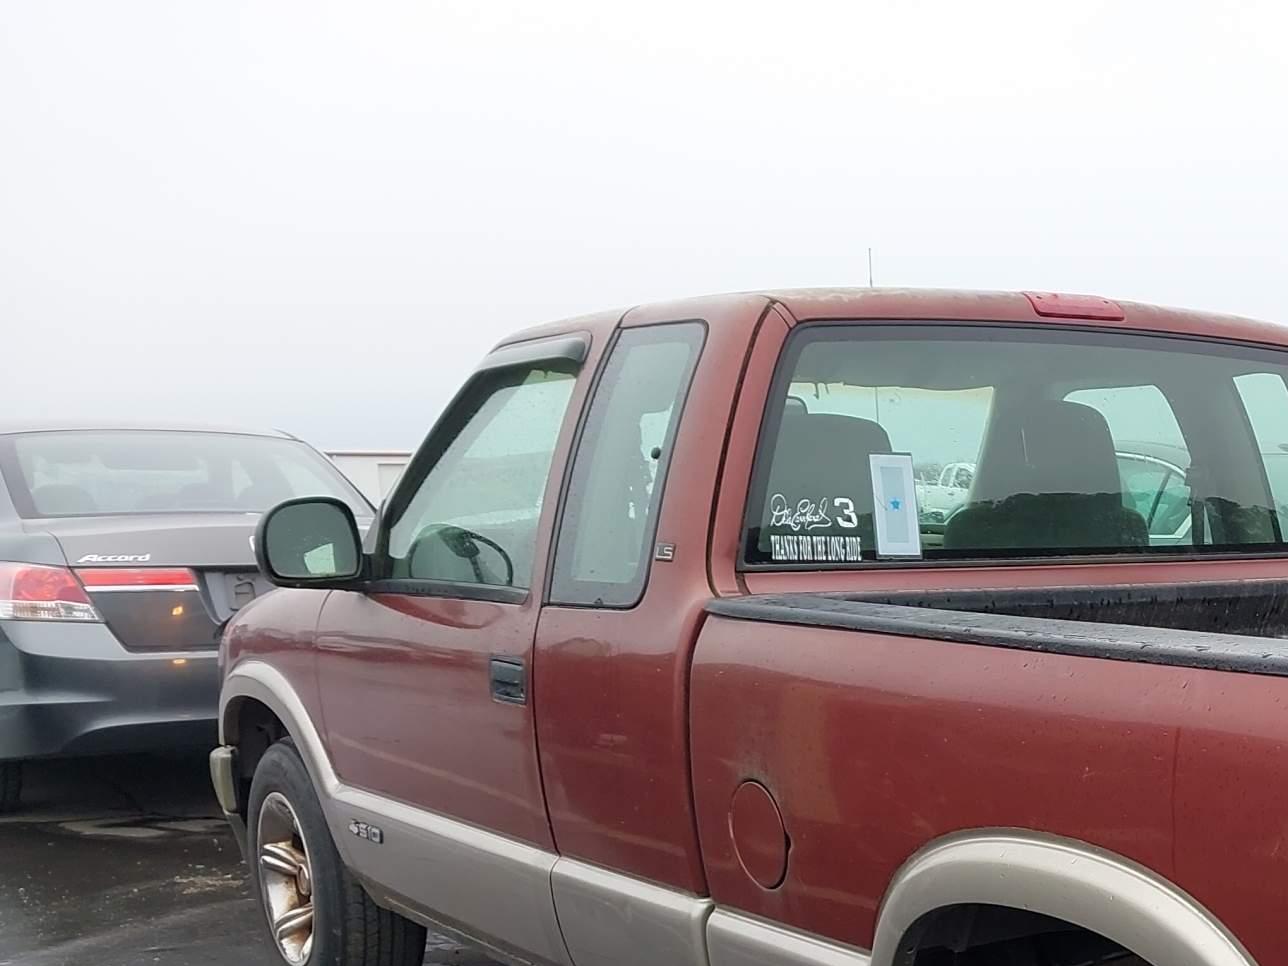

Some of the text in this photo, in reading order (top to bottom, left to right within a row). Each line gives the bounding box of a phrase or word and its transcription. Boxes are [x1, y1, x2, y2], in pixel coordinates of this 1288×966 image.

[834, 497, 858, 528] 3
[77, 553, 151, 563] Accord
[655, 545, 674, 560] LS
[770, 535, 862, 561] THANKS FOR THE LONG RIDE
[359, 821, 384, 844] S10
